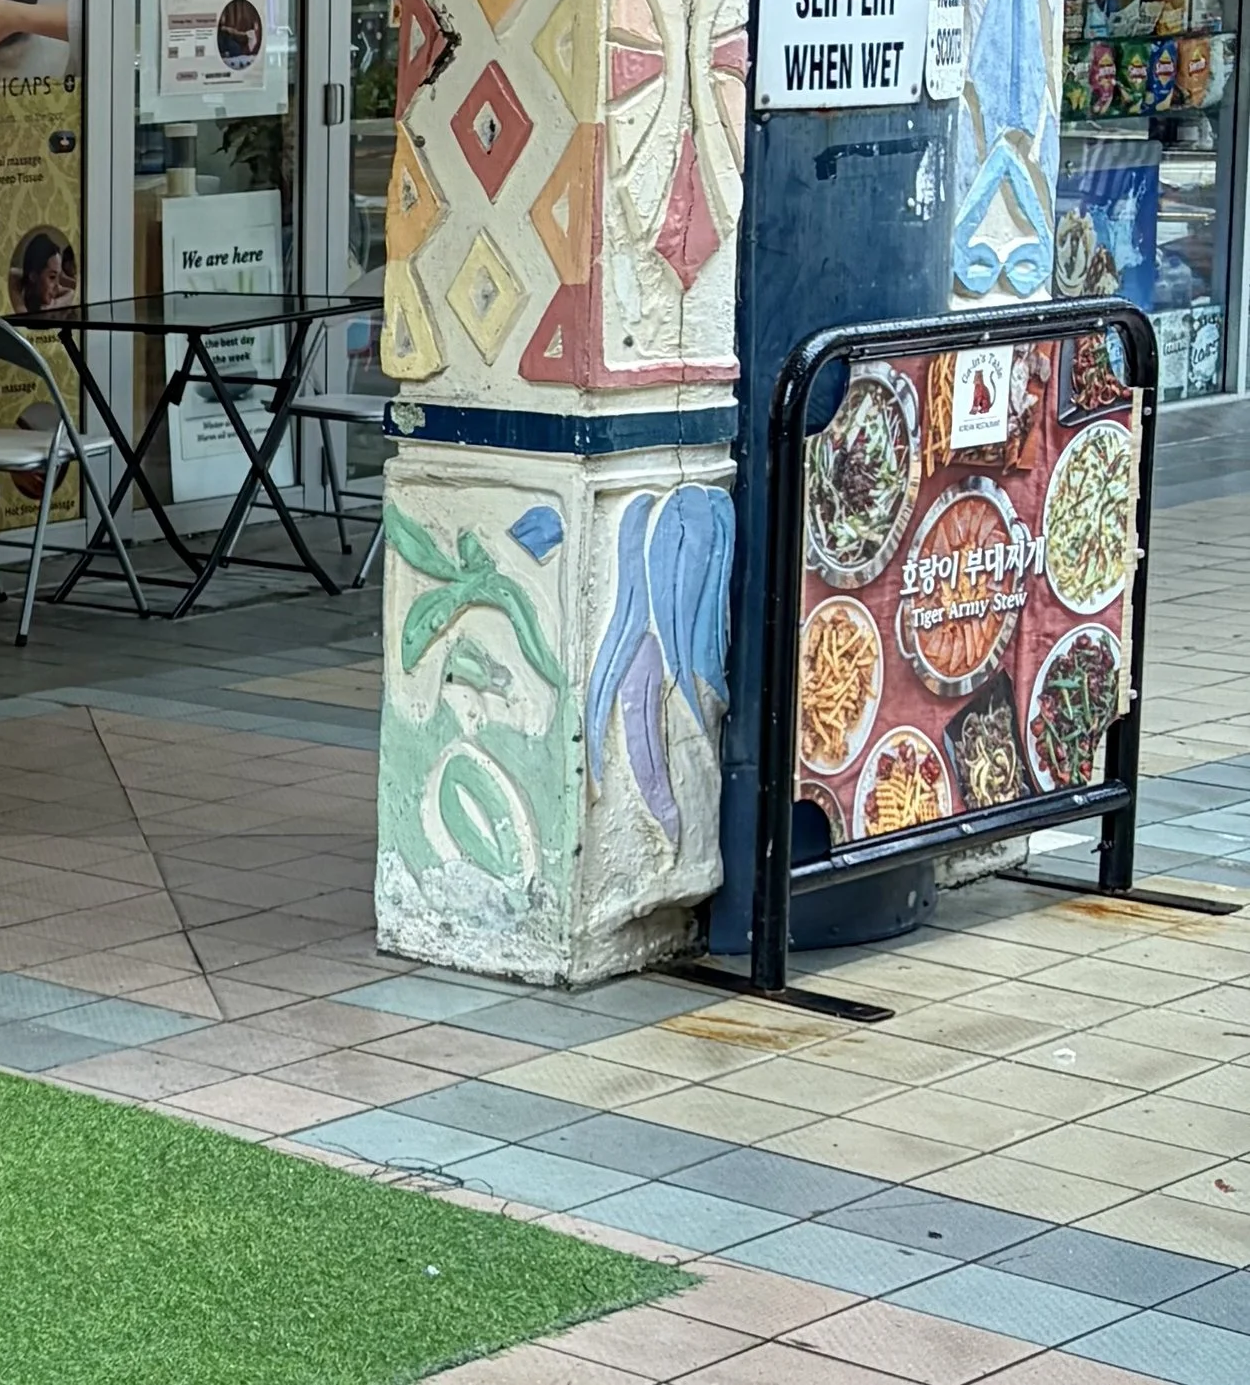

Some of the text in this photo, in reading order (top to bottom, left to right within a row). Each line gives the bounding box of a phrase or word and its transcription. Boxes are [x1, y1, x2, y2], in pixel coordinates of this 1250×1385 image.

[784, 41, 904, 92] WHEN WET
[182, 246, 264, 269] We are here
[220, 336, 238, 347] best
[899, 535, 1046, 595] 호랑이 부대찌개
[912, 591, 1028, 629] Tiger Army Stew
